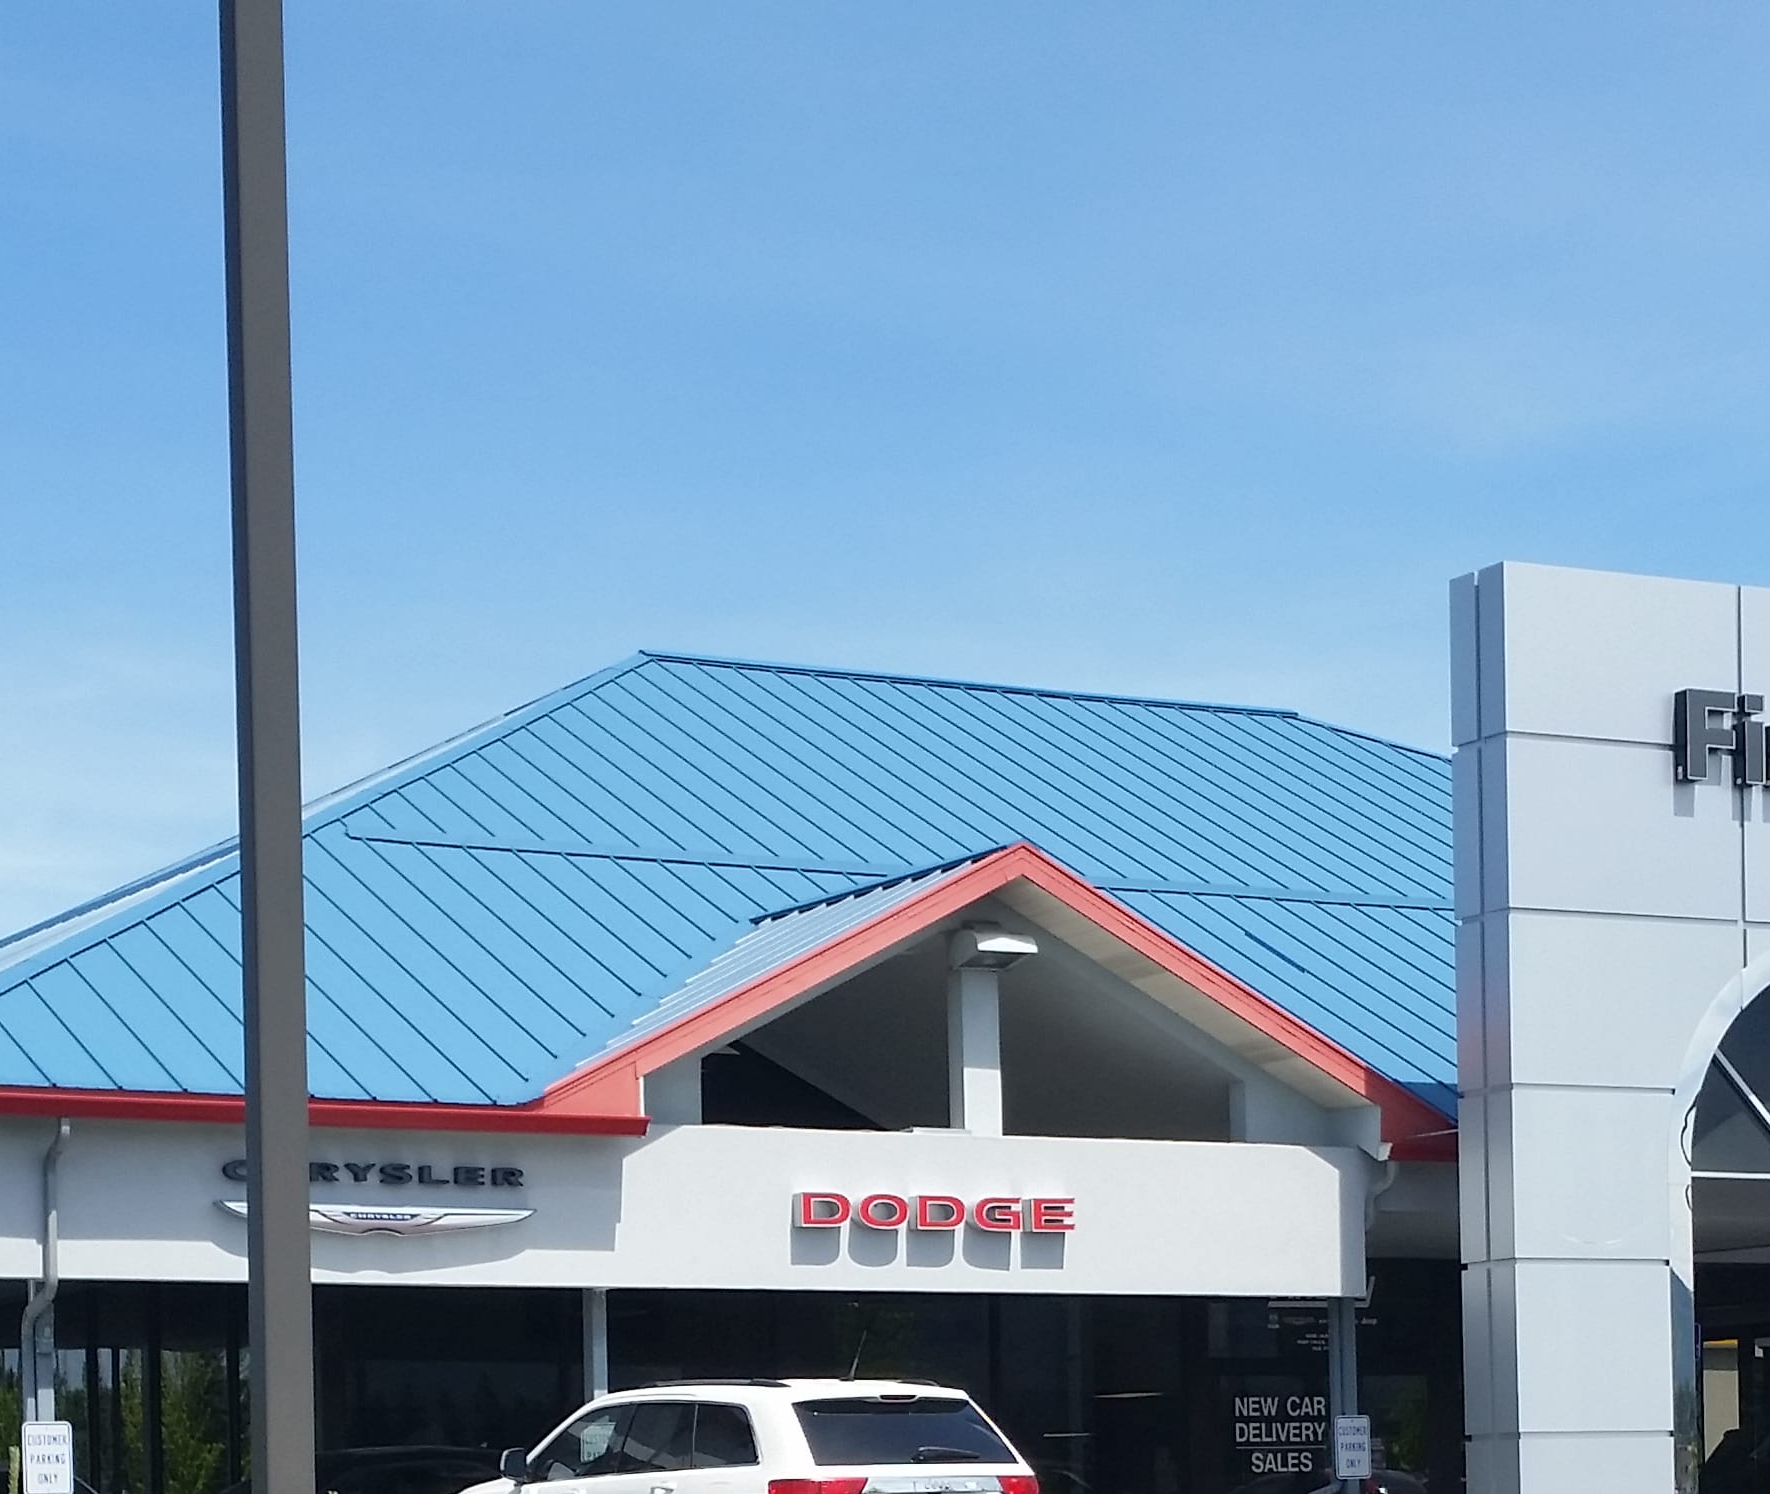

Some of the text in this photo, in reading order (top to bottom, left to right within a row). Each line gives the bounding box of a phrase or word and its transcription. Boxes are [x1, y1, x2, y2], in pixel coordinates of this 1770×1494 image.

[221, 1159, 525, 1188] CRYSLER
[792, 1192, 1076, 1233] DODGE
[1234, 1396, 1326, 1417] NEW CAR
[27, 1434, 69, 1446] CUSTOMER
[1235, 1422, 1326, 1442] DELIVERY
[1340, 1442, 1366, 1452] PARKING
[30, 1454, 66, 1465] PARKING
[1251, 1452, 1313, 1473] SALES
[37, 1473, 59, 1484] ONLY
